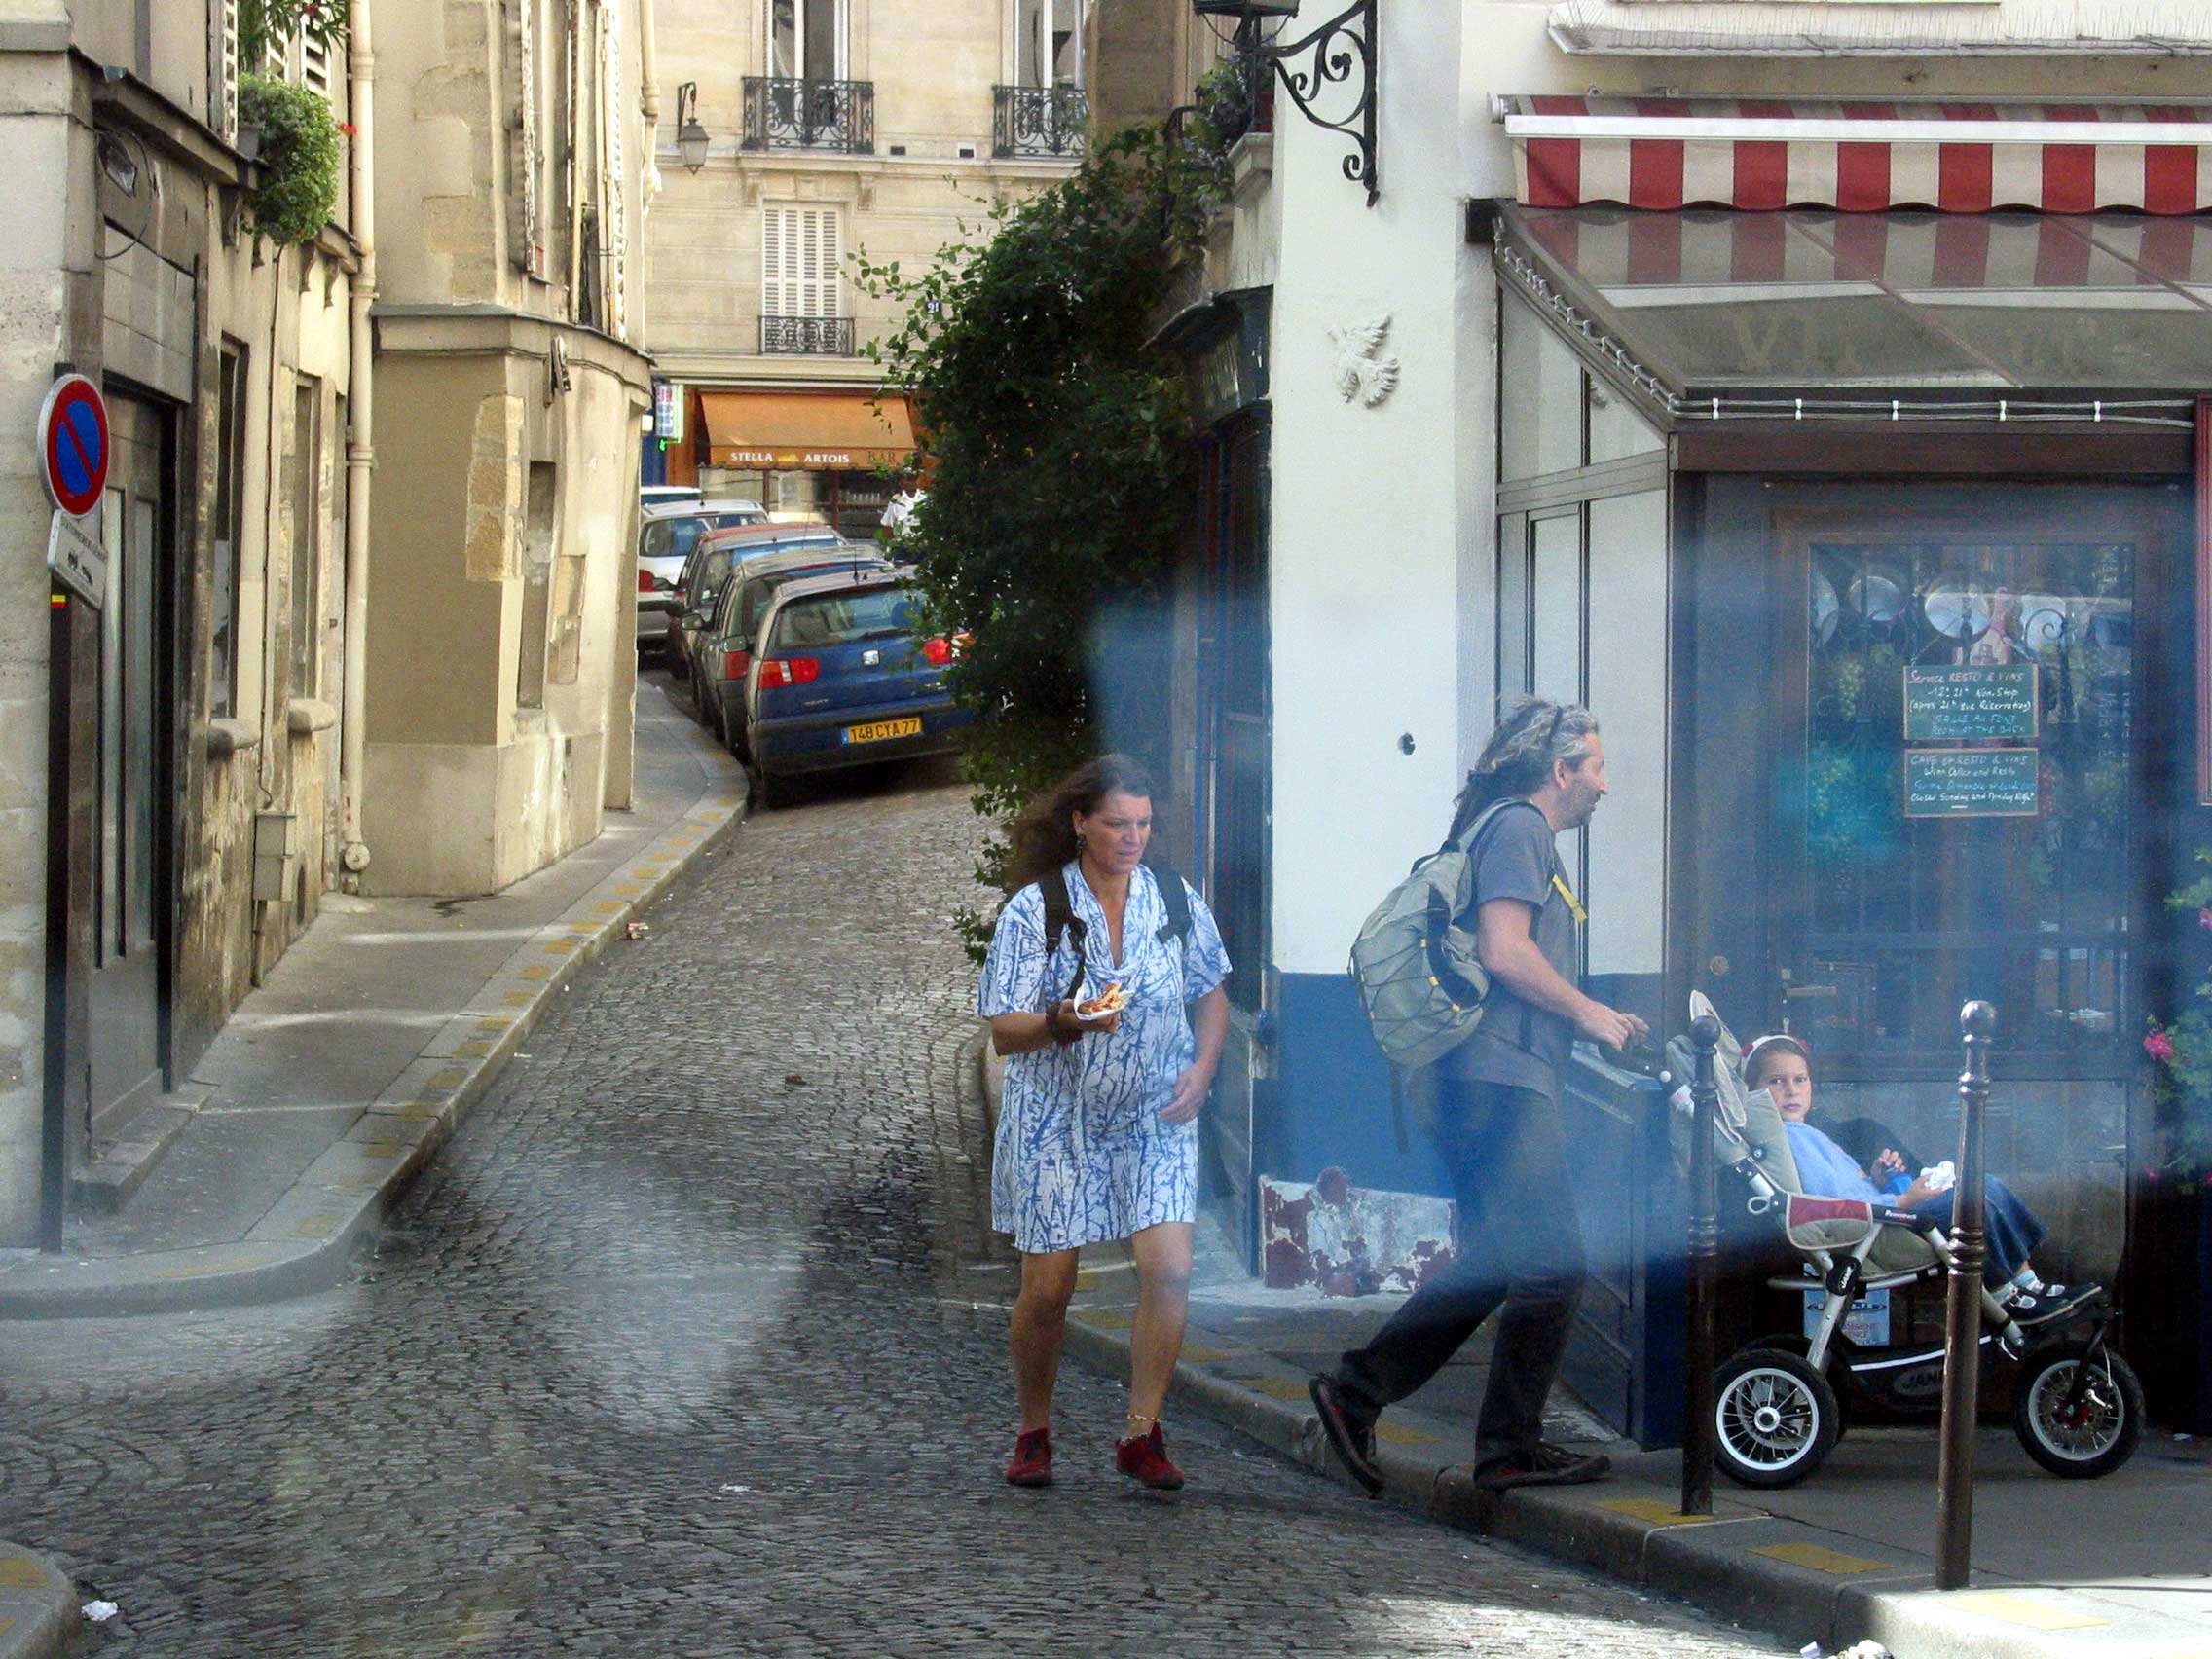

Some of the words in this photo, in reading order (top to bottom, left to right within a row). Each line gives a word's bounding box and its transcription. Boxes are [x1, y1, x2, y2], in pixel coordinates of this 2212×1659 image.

[731, 452, 773, 462] STELLA
[804, 453, 850, 463] ARTOIS
[850, 725, 874, 741] 148
[875, 722, 901, 738] CYA
[902, 720, 918, 733] 77
